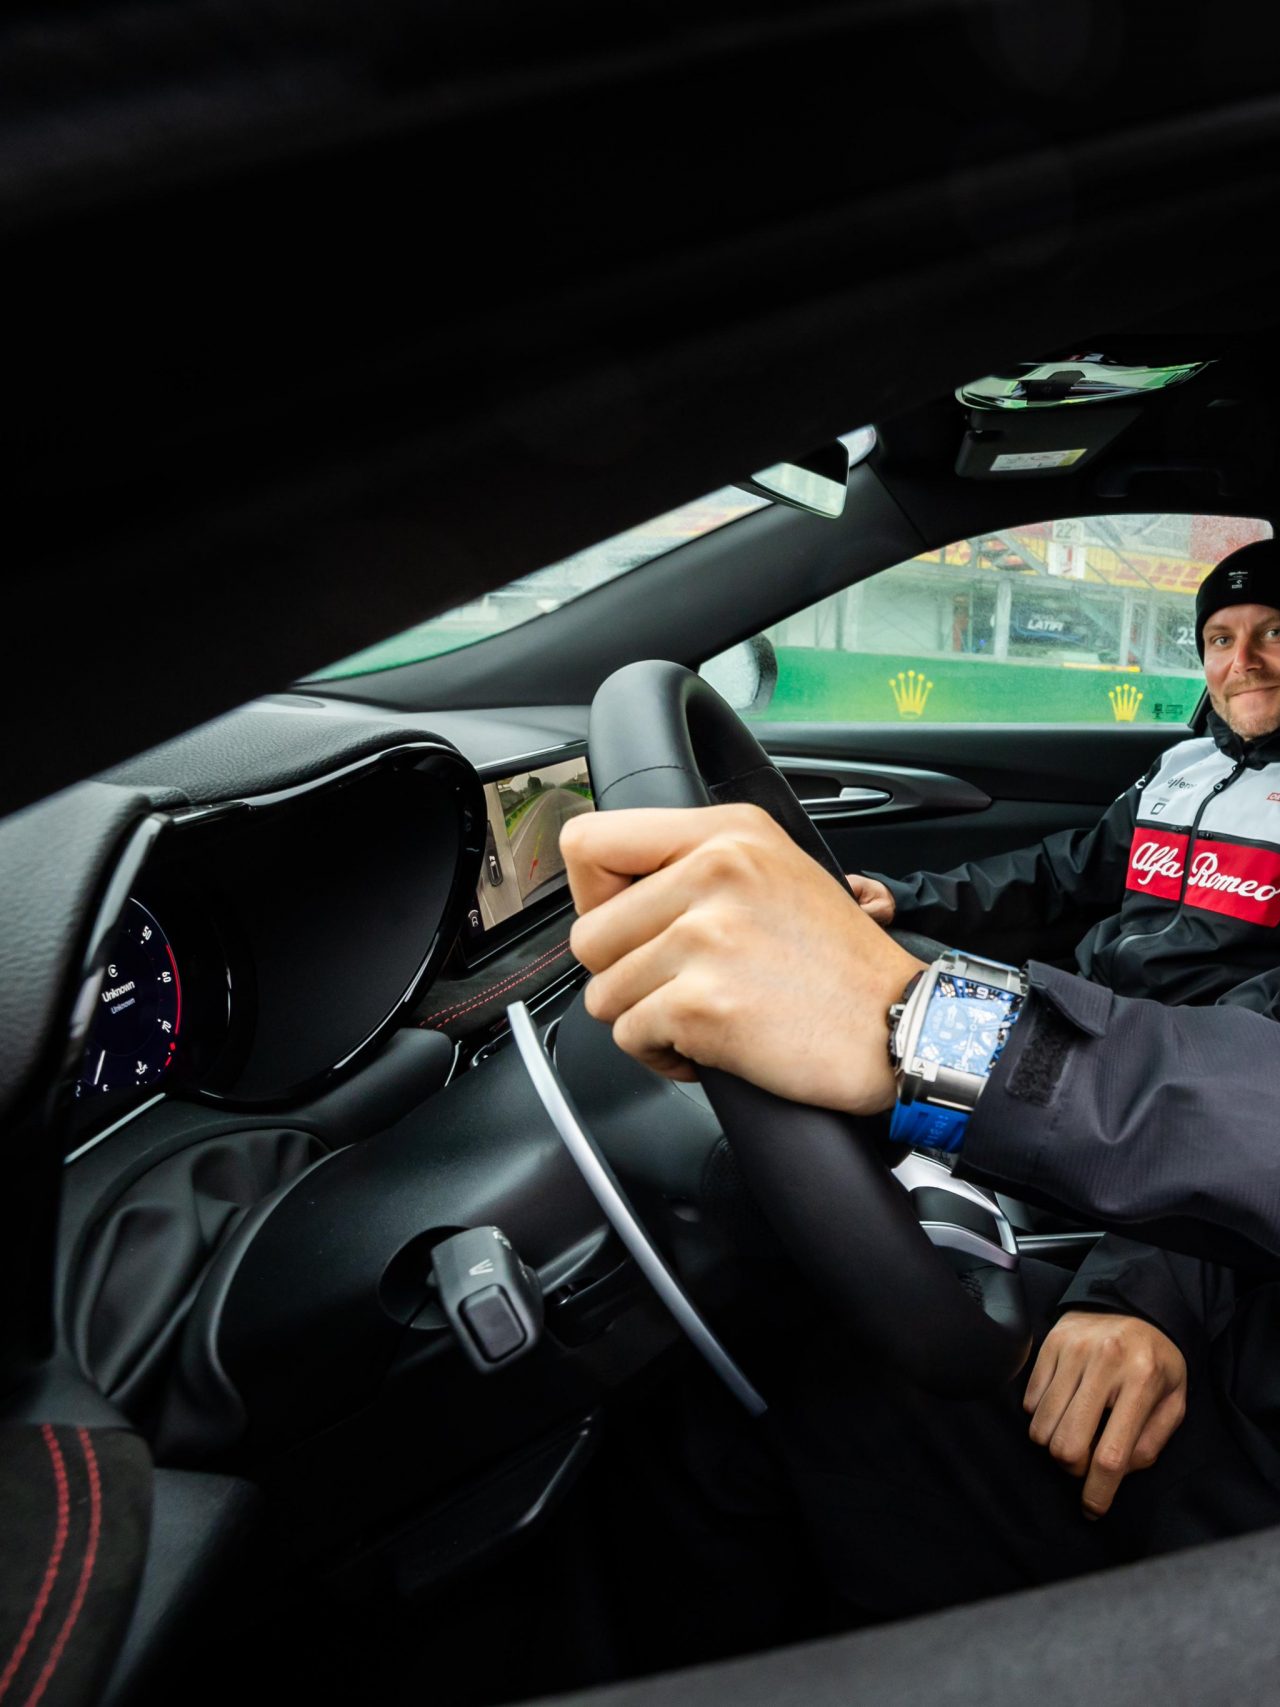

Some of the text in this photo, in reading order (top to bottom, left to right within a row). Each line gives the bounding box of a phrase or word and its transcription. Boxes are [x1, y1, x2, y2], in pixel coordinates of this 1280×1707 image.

[1027, 618, 1065, 632] LATIFI
[1131, 842, 1184, 885] Alfa
[142, 926, 152, 940] 50
[161, 971, 172, 983] 60
[101, 981, 136, 1003] Unknown
[110, 998, 136, 1015] Unknown
[161, 1020, 172, 1034] 70
